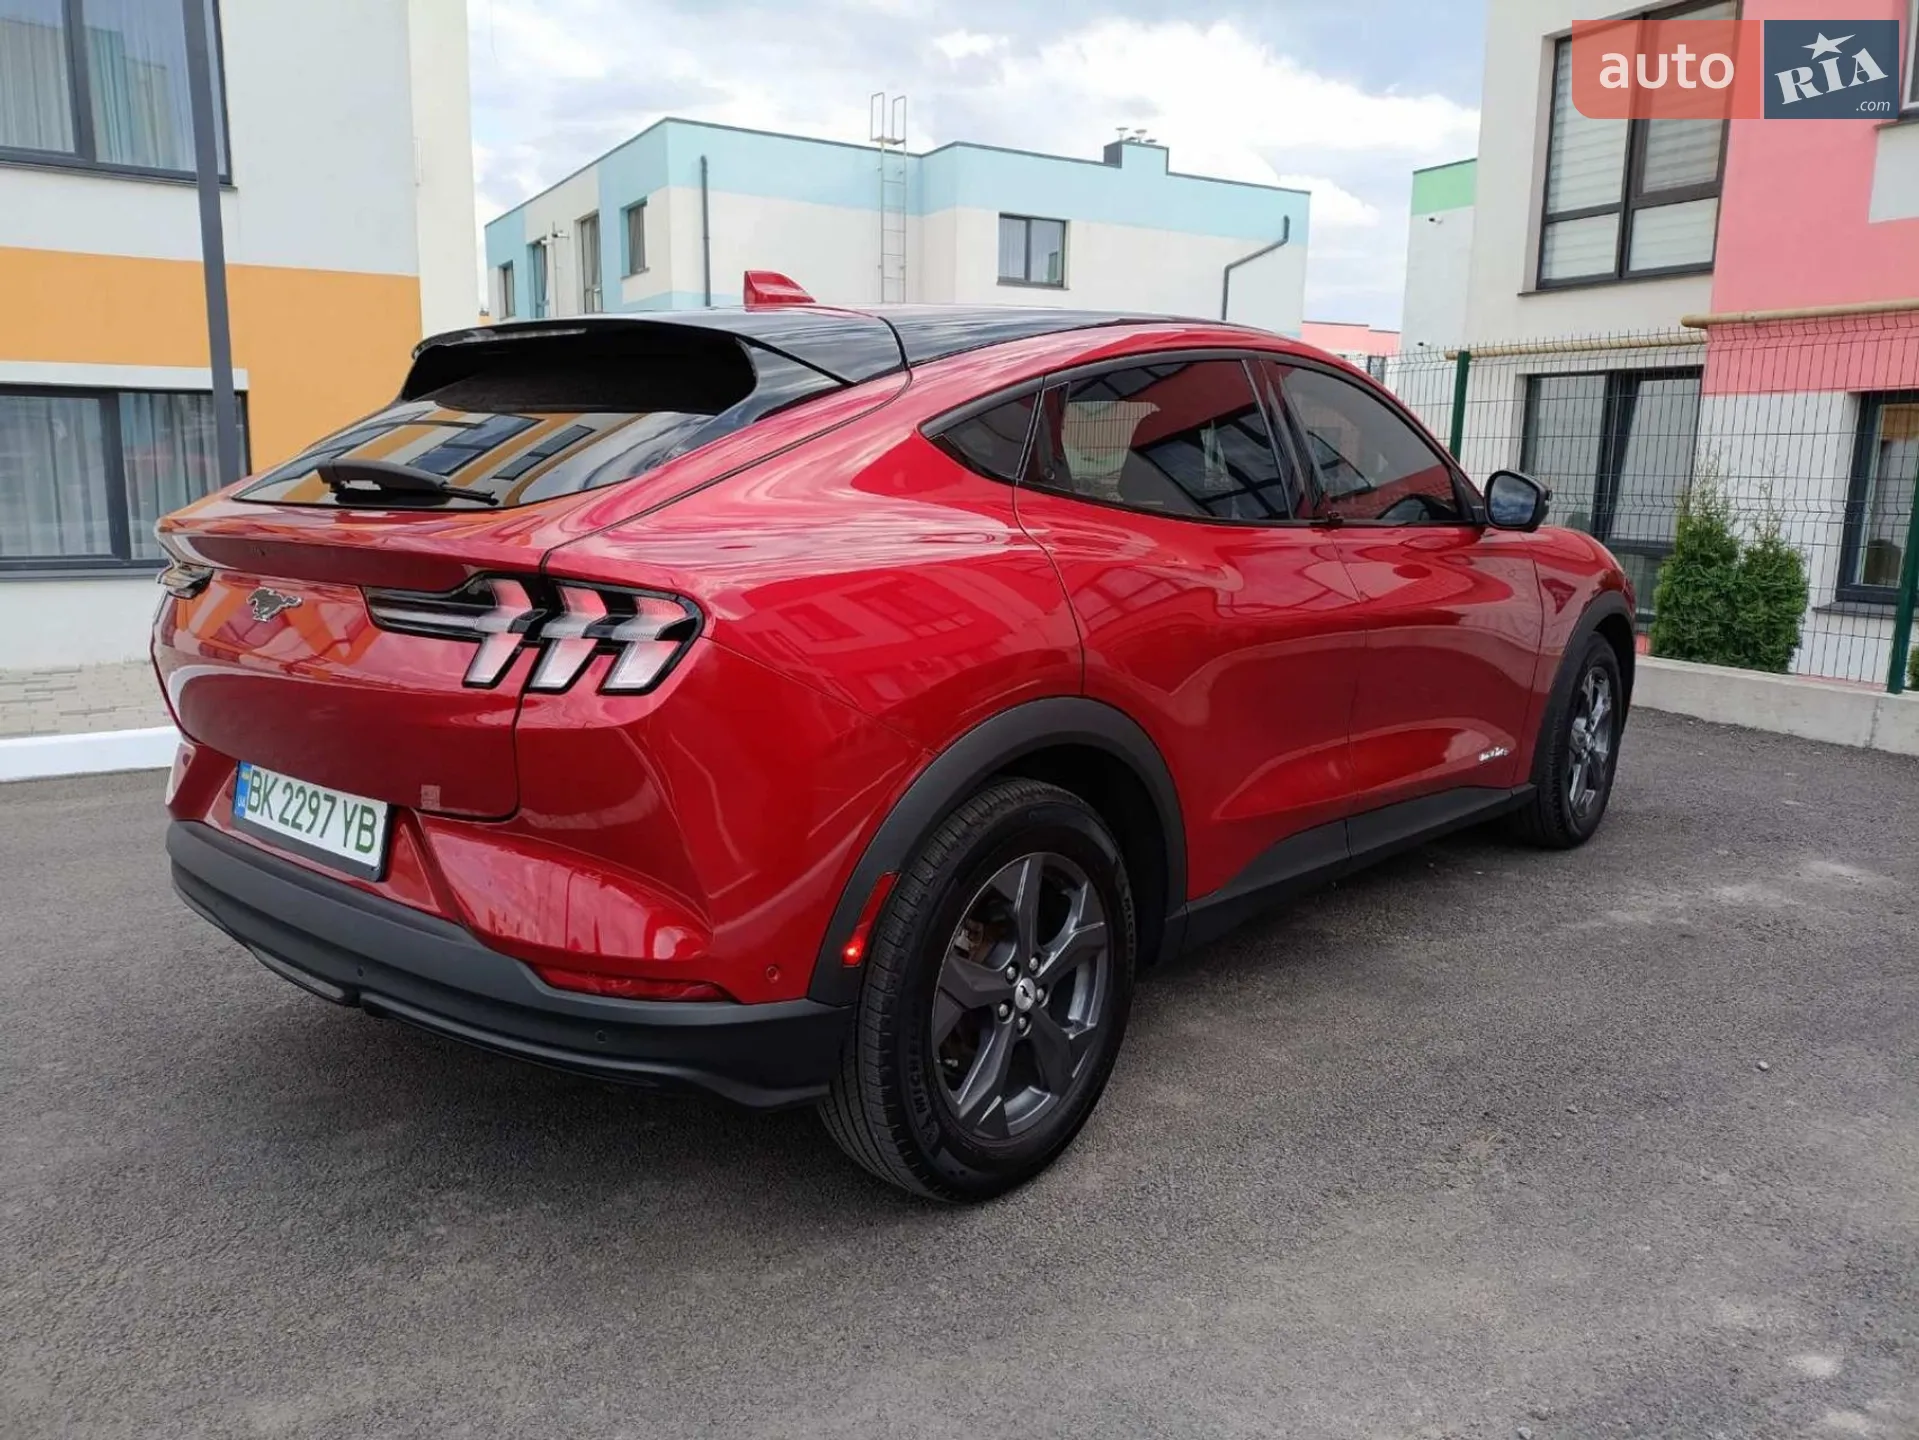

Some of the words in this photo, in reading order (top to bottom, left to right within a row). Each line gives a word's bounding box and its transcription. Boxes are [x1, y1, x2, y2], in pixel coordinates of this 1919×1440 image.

[247, 769, 279, 821] BK
[278, 781, 337, 839] 2297
[343, 799, 377, 854] YB
